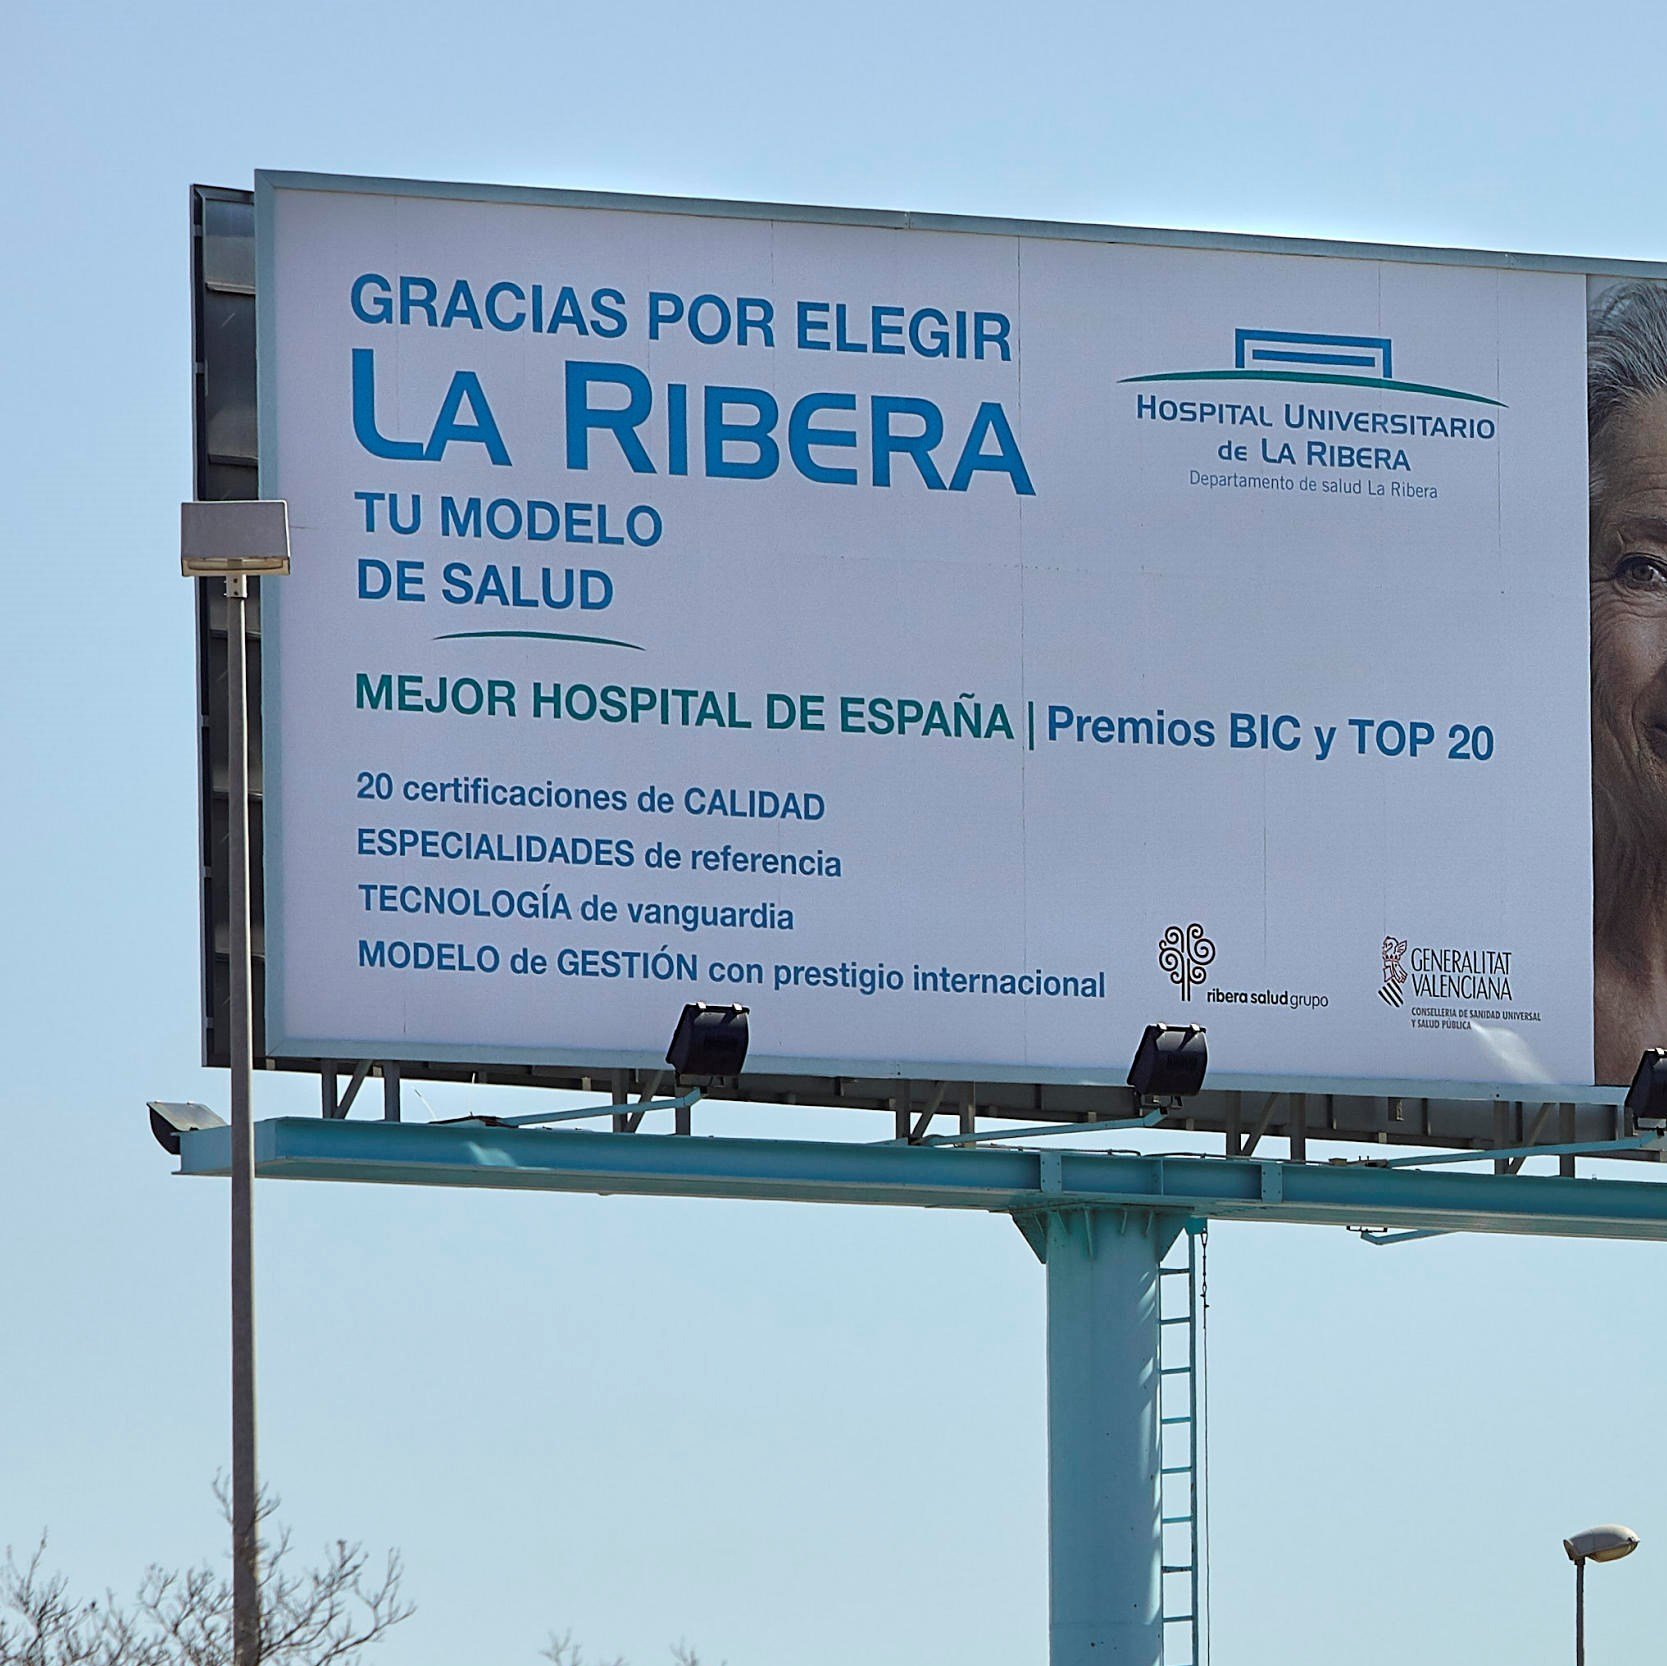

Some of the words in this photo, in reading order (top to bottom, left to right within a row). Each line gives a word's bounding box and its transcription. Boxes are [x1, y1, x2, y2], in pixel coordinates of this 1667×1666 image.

[351, 274, 627, 338] GRACIAS
[649, 292, 774, 347] POR
[797, 301, 1011, 361] ELEGIR
[352, 348, 512, 466] LA
[565, 360, 1036, 496] RIBERA
[1138, 395, 1272, 426] HOSPITAL
[1285, 404, 1495, 439] UNIVERSITARIO
[1218, 440, 1247, 461] de
[1262, 438, 1296, 464] LA
[1308, 441, 1411, 471] RIBERA
[1191, 470, 1294, 490] Departamento
[1300, 476, 1316, 491] de
[1322, 479, 1361, 494] salud
[1368, 480, 1384, 495] La
[1392, 482, 1437, 498] Ribera
[355, 492, 420, 534] TU
[441, 496, 662, 547] MODELO
[358, 559, 425, 601] DE
[442, 563, 613, 610] SALUD
[357, 673, 516, 717] MEJOR
[533, 682, 751, 728] HOSPITAL
[767, 694, 824, 731] DE
[841, 693, 1014, 739] ESPAÑA
[1048, 706, 1215, 747] Premios
[1231, 713, 1300, 751] BIC
[1314, 726, 1336, 760] y
[1349, 719, 1434, 757] TOP
[1448, 725, 1493, 760] 20
[357, 772, 393, 799] 20
[403, 777, 627, 810] certificaciones
[638, 786, 674, 813] de
[685, 788, 824, 820] CALIDAD
[358, 828, 634, 866] ESPECIALIDADES
[645, 842, 681, 869] de
[692, 845, 841, 877] referencia
[358, 884, 572, 919] TECNOLOGÍA
[581, 895, 617, 921] de
[628, 903, 793, 931] vanguardia
[359, 940, 499, 972] MODELO
[511, 948, 547, 974] de
[558, 945, 697, 980] GESTIÓN
[709, 963, 762, 983] con
[775, 962, 903, 995] prestigio
[914, 965, 1104, 997] internacional
[1411, 948, 1511, 974] GENERALITAT
[1208, 988, 1247, 1003] ribera
[1412, 974, 1512, 1000] VALENCIANA
[1412, 1008, 1456, 1017] CONSELLERIA
[1470, 1010, 1500, 1019] SANIDAD
[1503, 1011, 1541, 1021] UNIVERSAL
[1418, 1020, 1439, 1028] SALUD
[1442, 1018, 1471, 1029] PÚBLICA
